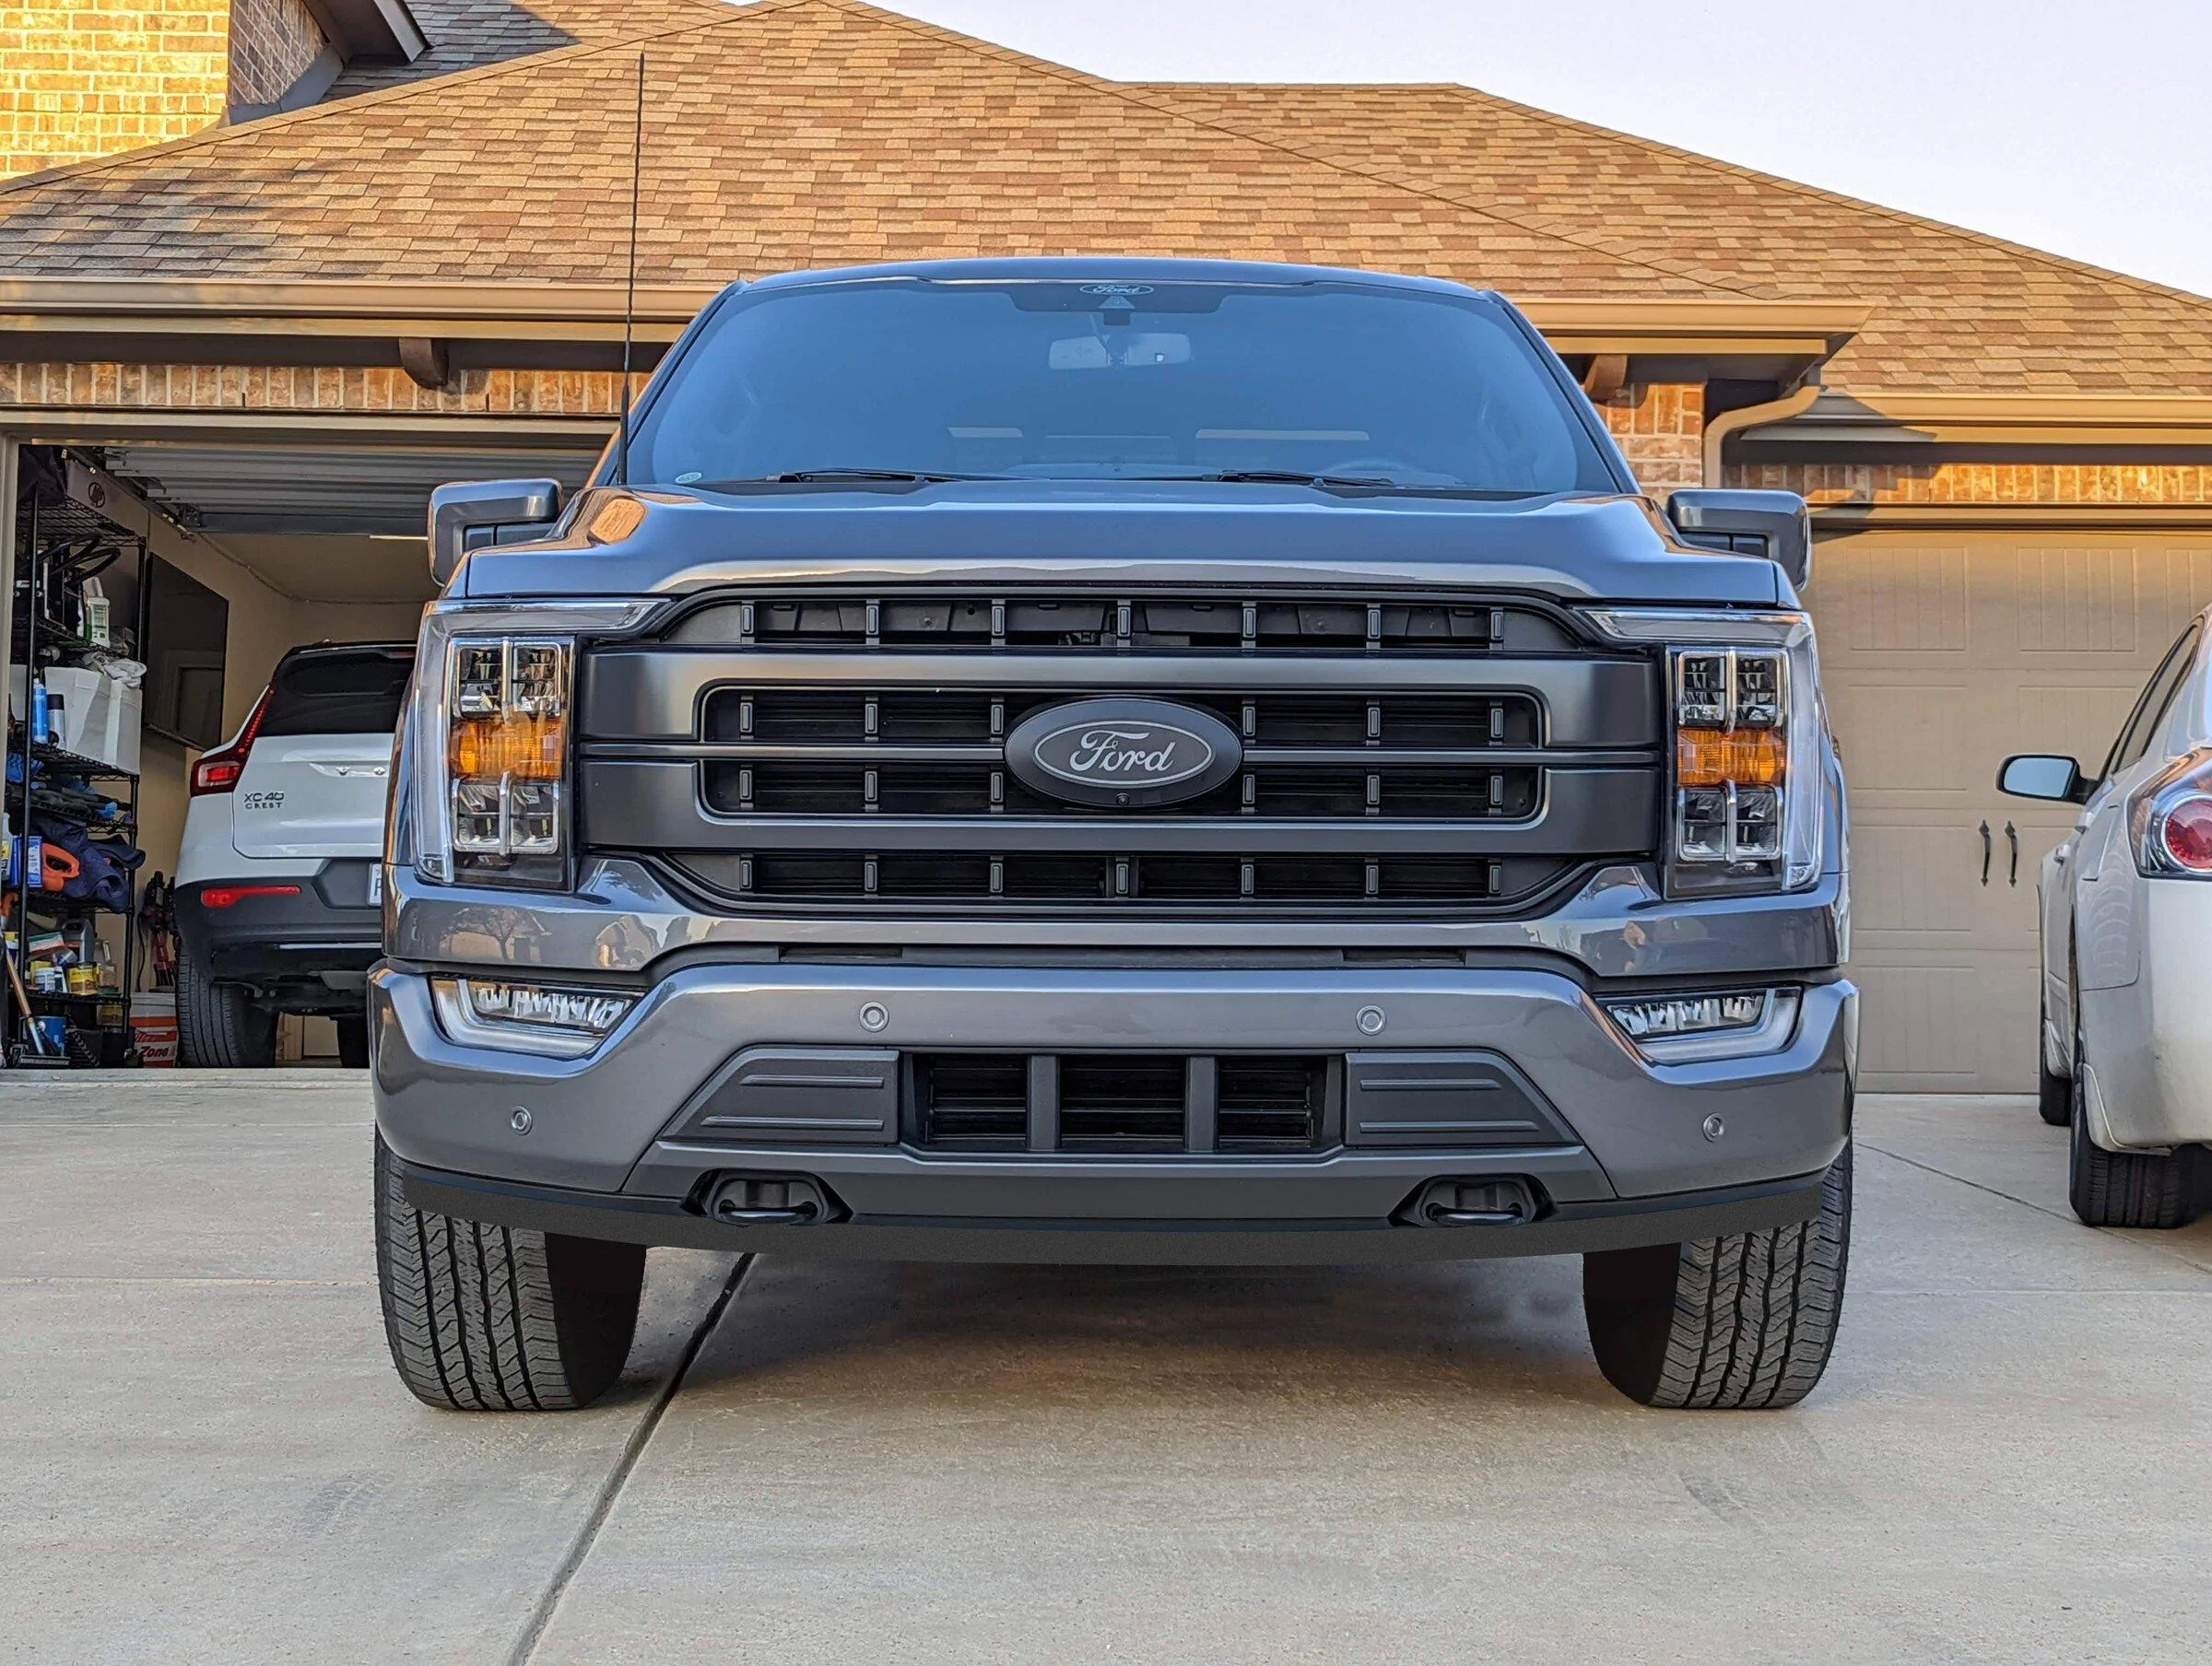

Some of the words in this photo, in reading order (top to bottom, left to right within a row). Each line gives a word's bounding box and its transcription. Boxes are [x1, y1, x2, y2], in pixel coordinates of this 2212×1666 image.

[1092, 285, 1140, 294] Ford
[1069, 729, 1176, 771] Ford
[243, 792, 285, 803] XC40
